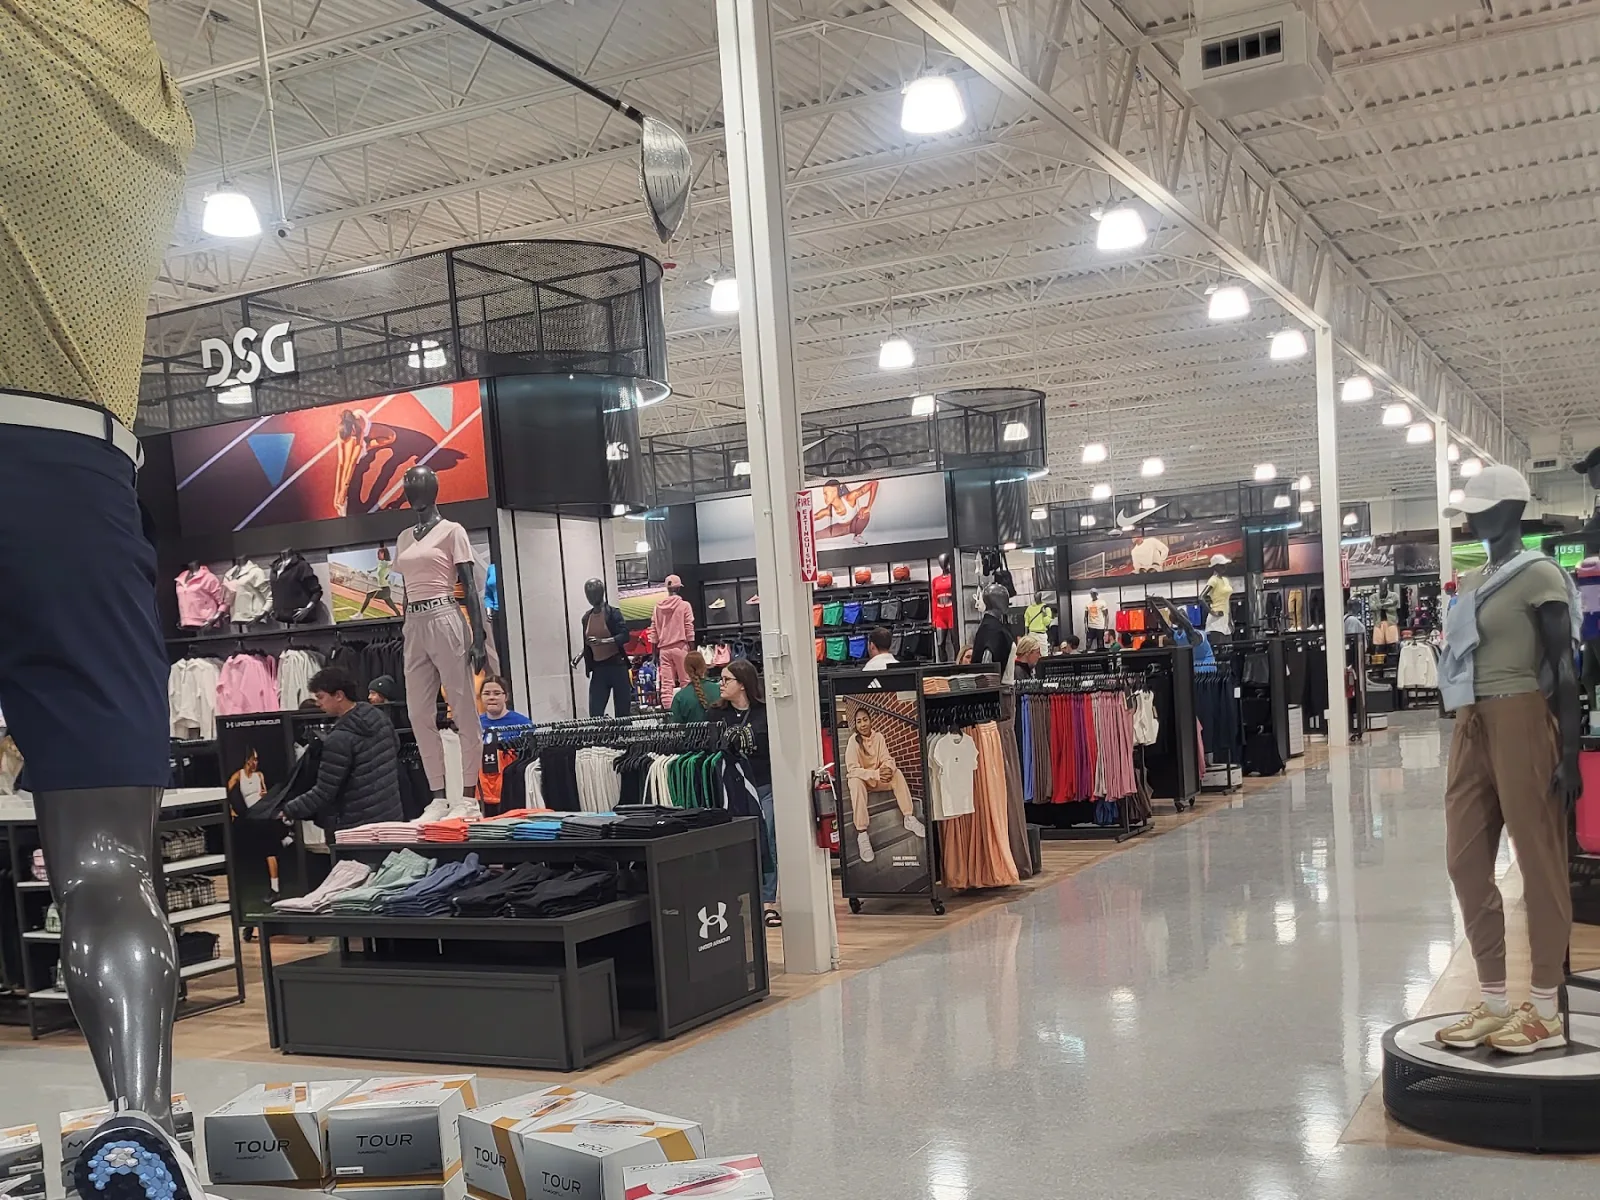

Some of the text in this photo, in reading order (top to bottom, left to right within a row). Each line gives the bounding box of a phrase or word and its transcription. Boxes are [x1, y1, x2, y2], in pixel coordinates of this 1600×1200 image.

[201, 322, 295, 388] DSG
[797, 497, 811, 507] FIRE
[802, 509, 812, 575] EXTINGUISHER
[234, 1140, 290, 1154] TOUR
[356, 1133, 413, 1148] TOUR
[474, 1146, 507, 1168] TOUR
[542, 1171, 582, 1195] TOUR
